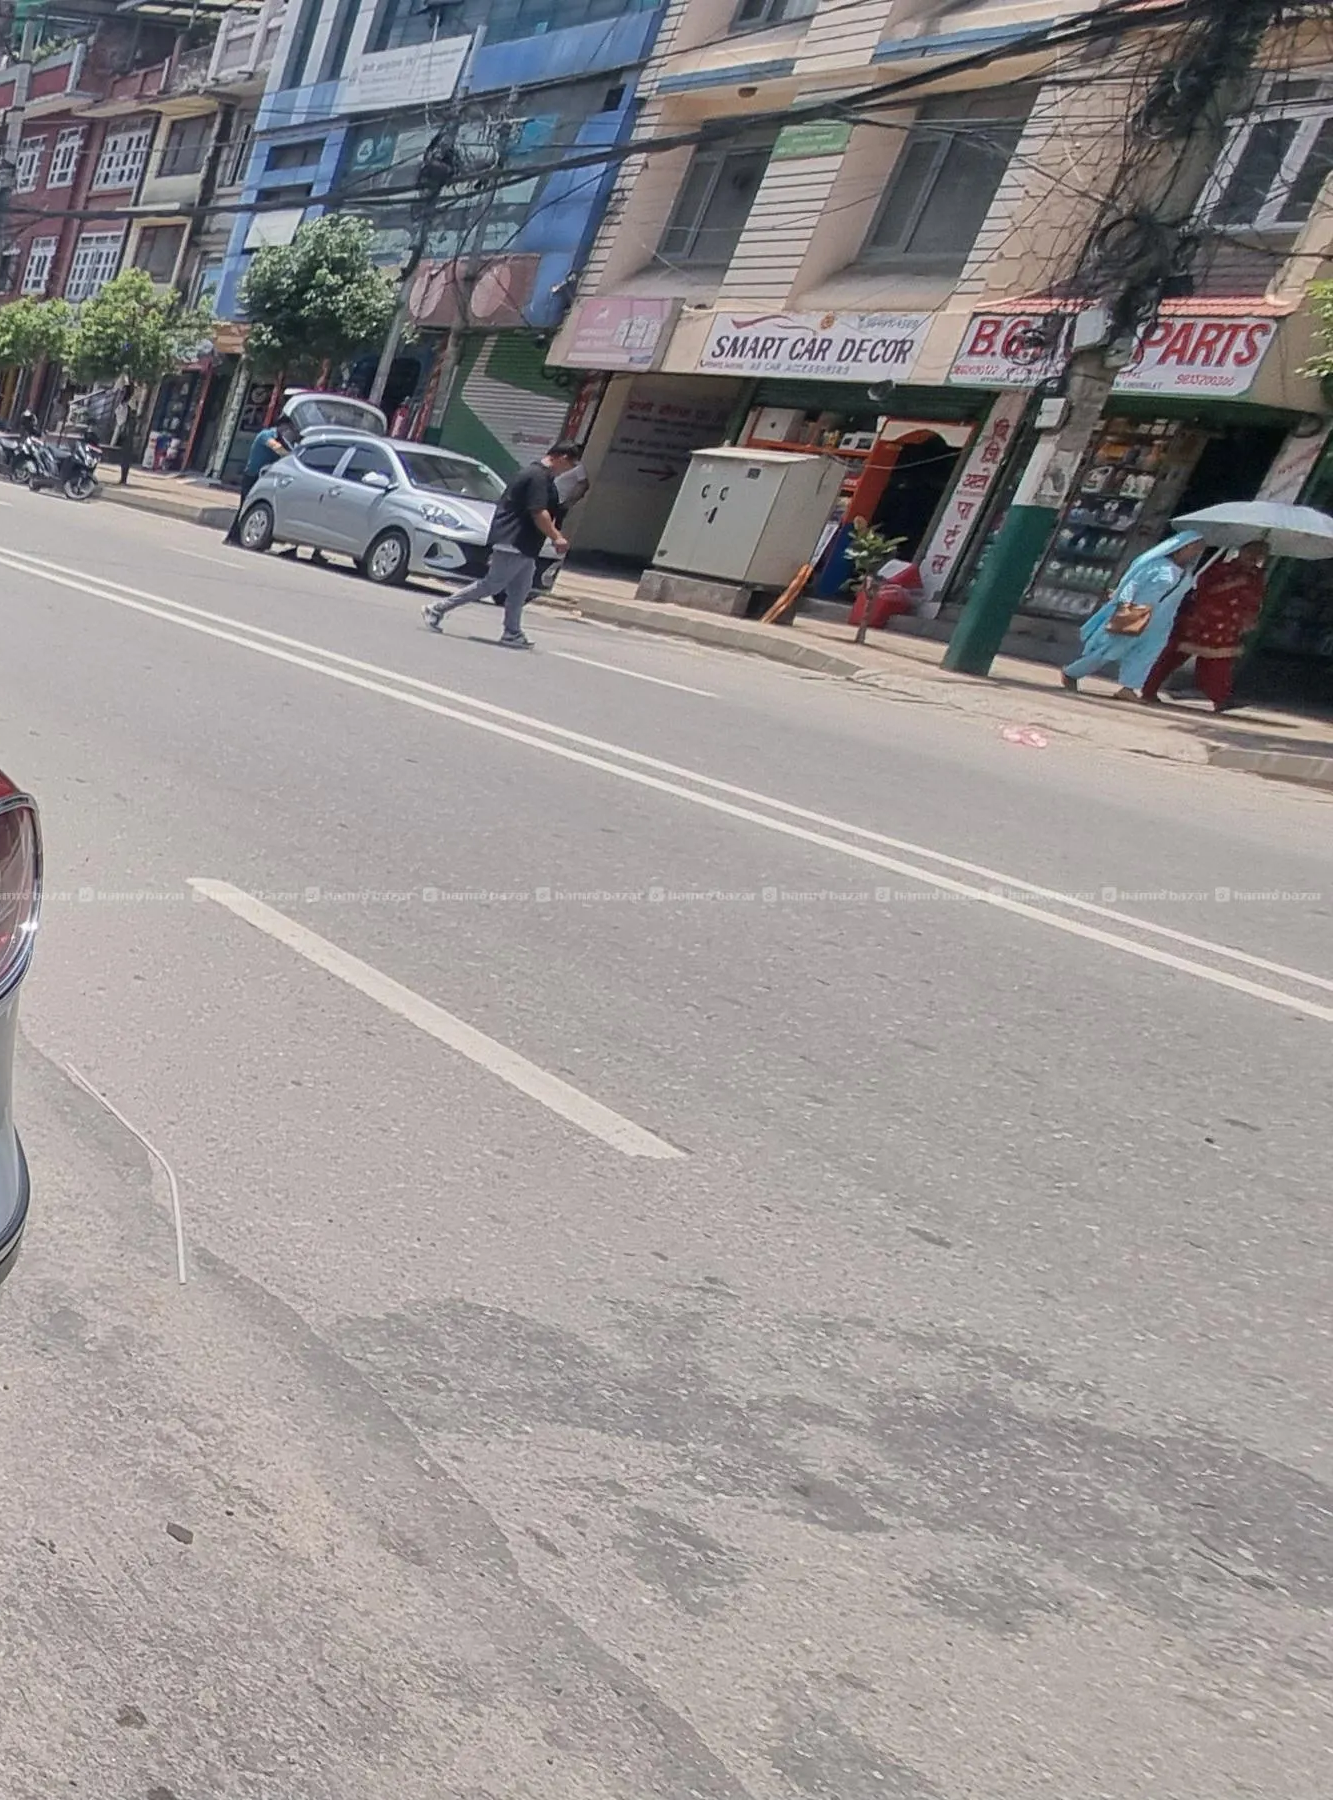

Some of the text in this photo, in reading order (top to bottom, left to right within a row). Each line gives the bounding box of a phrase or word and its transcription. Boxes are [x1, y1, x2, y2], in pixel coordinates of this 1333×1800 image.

[711, 335, 915, 365] SMART CAR DECOR
[1133, 321, 1270, 367] PARTS
